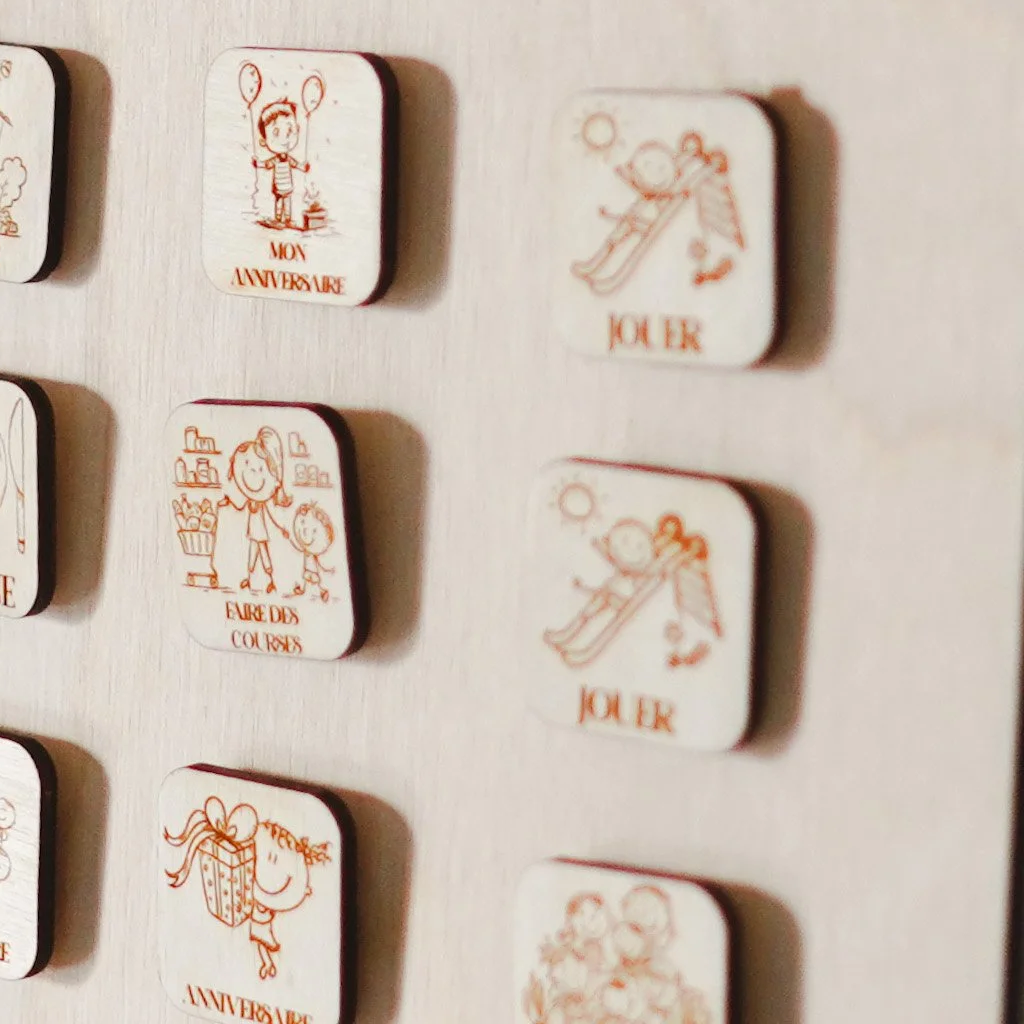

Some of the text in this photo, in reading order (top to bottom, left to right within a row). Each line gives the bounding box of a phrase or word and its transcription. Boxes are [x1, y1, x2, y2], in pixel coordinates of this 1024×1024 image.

[269, 241, 307, 261] MON
[230, 267, 346, 295] ANNIVERSAIRE
[607, 312, 704, 353] JOUER
[225, 600, 299, 625] FAIRE DES
[231, 629, 303, 654] COURSES
[578, 684, 676, 736] JOUER
